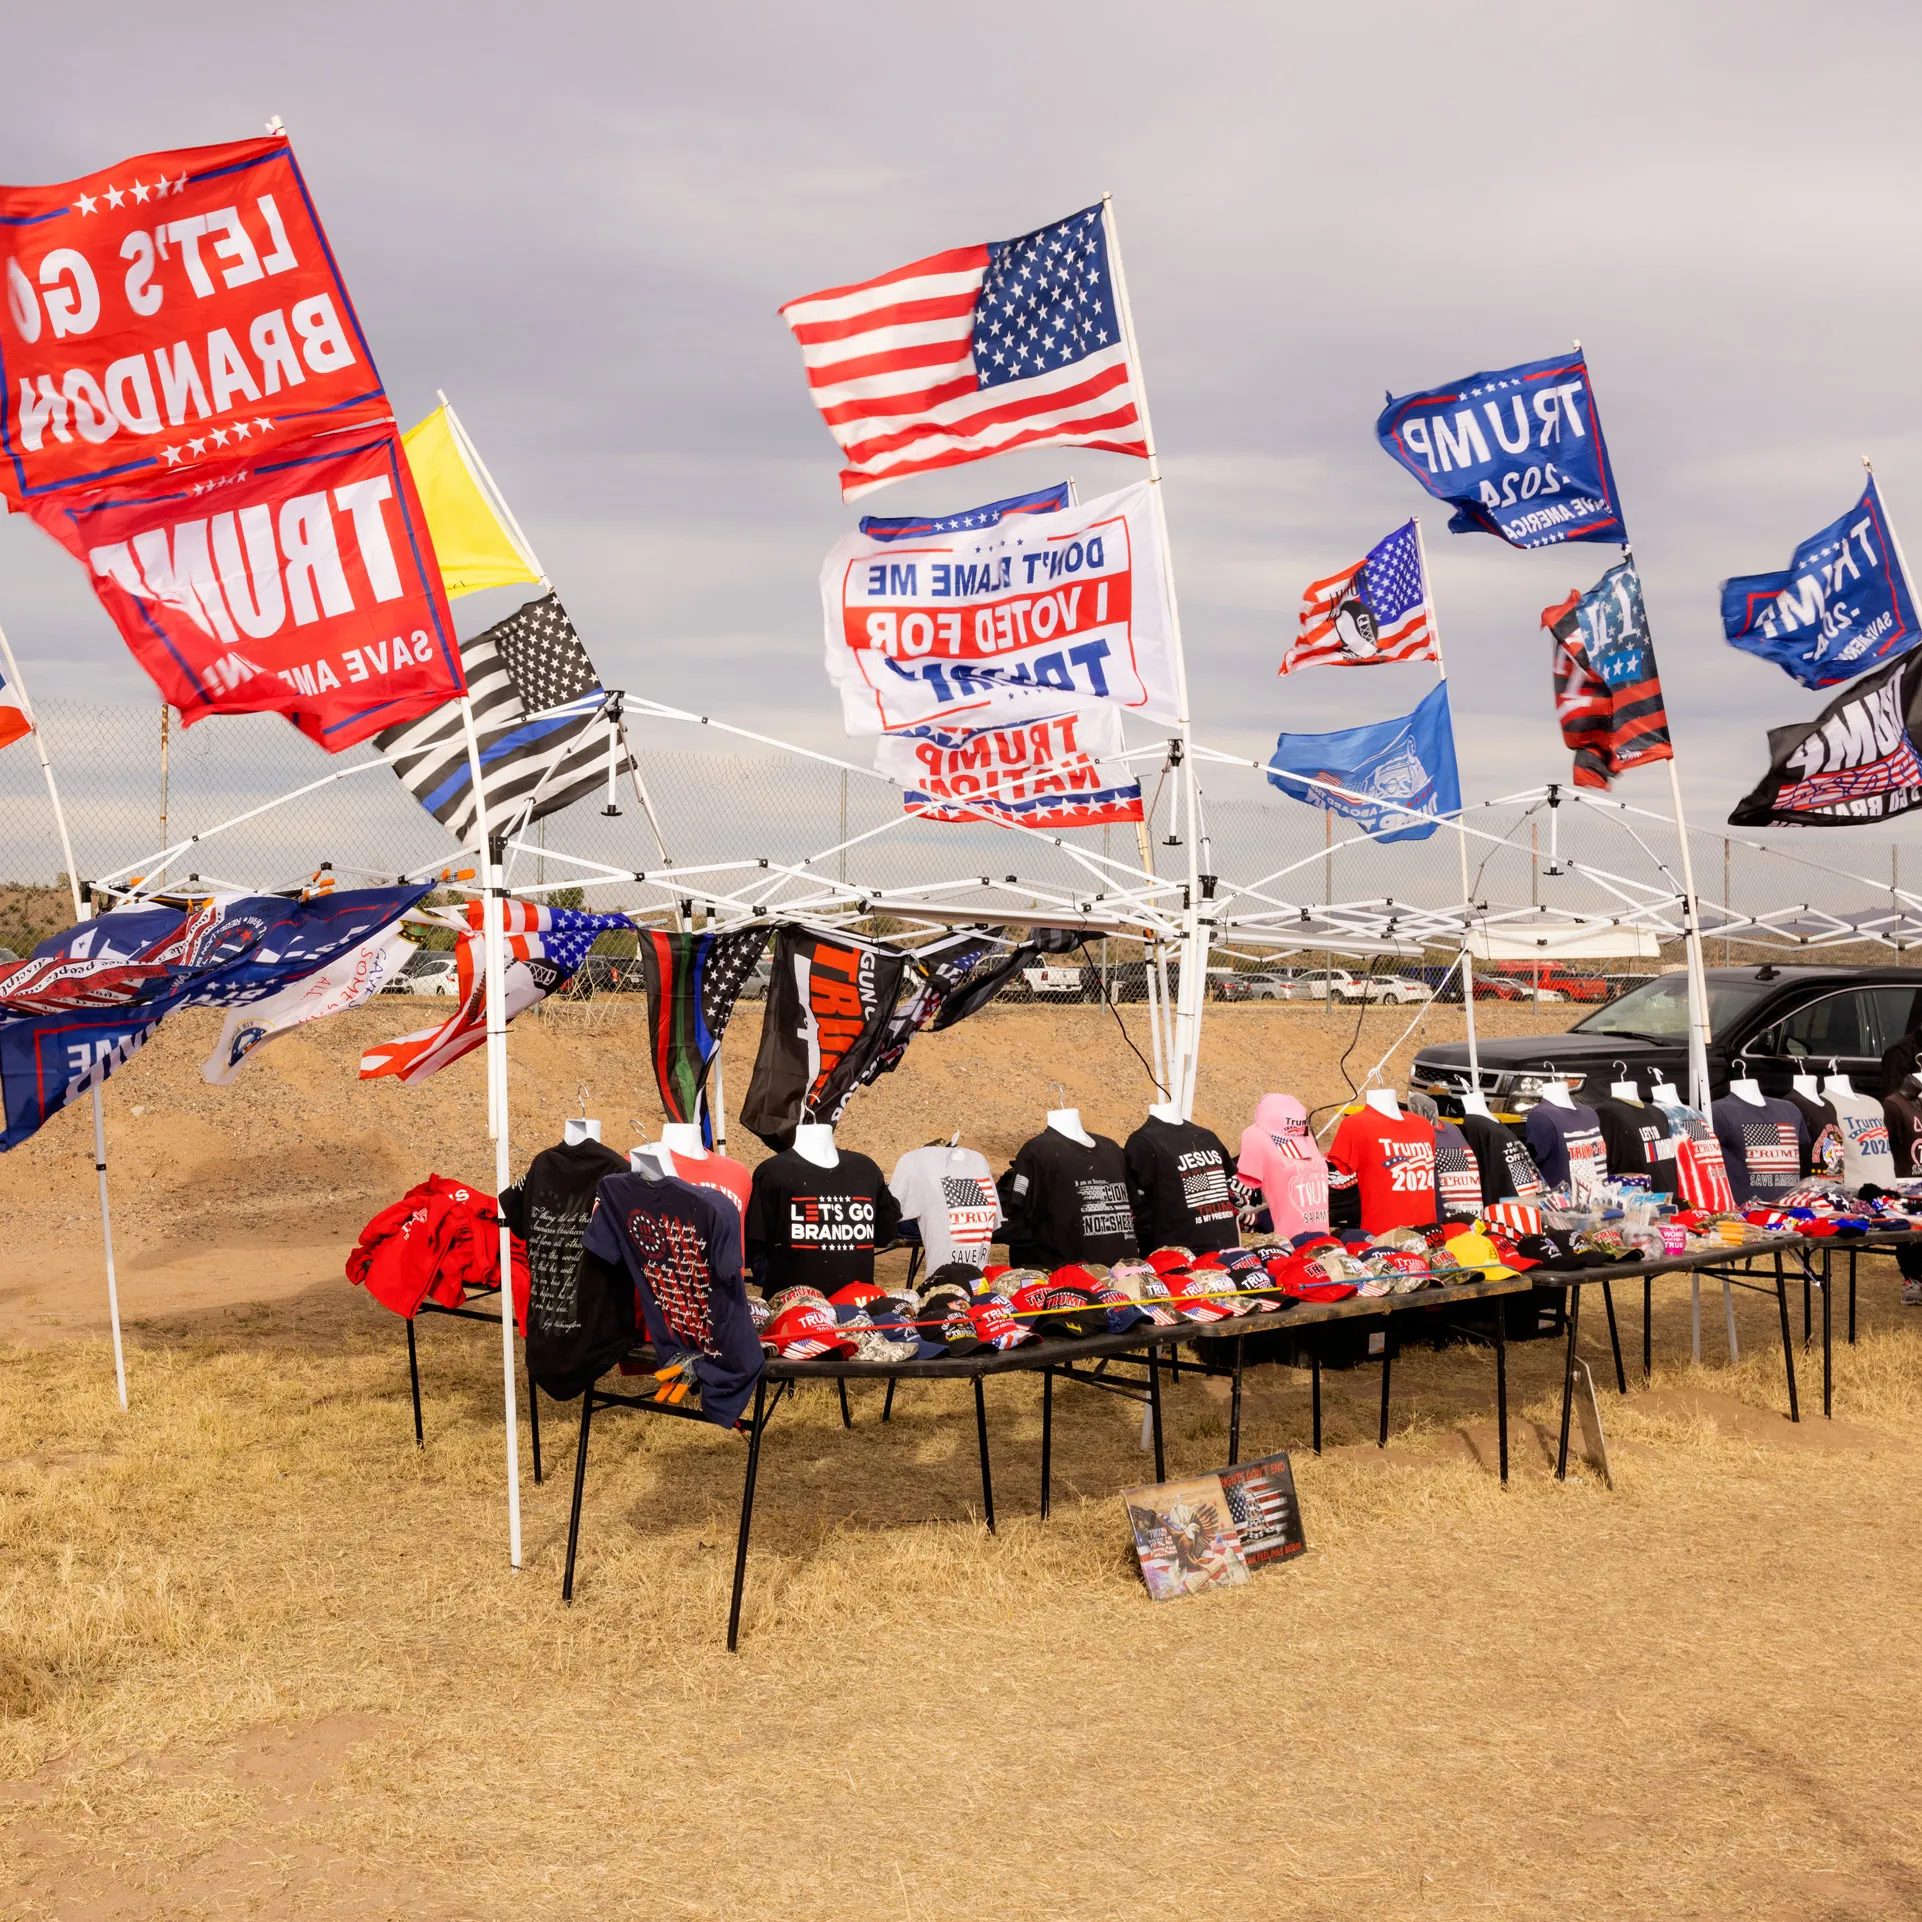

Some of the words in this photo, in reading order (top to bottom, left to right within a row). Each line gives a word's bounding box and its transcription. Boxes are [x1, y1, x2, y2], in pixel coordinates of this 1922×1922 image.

[1379, 1138, 1432, 1158] Trump
[1177, 1150, 1223, 1171] JESUS
[1392, 1169, 1435, 1192] 2024
[1750, 1174, 1774, 1187] SAVE
[791, 1203, 844, 1222] LET'S
[849, 1203, 875, 1220] GO
[791, 1223, 875, 1240] BRANDON
[780, 1289, 823, 1304] TRUMP
[1046, 1295, 1088, 1310] TRUMP
[1246, 1465, 1269, 1482] DON'T
[1270, 1462, 1286, 1474] END
